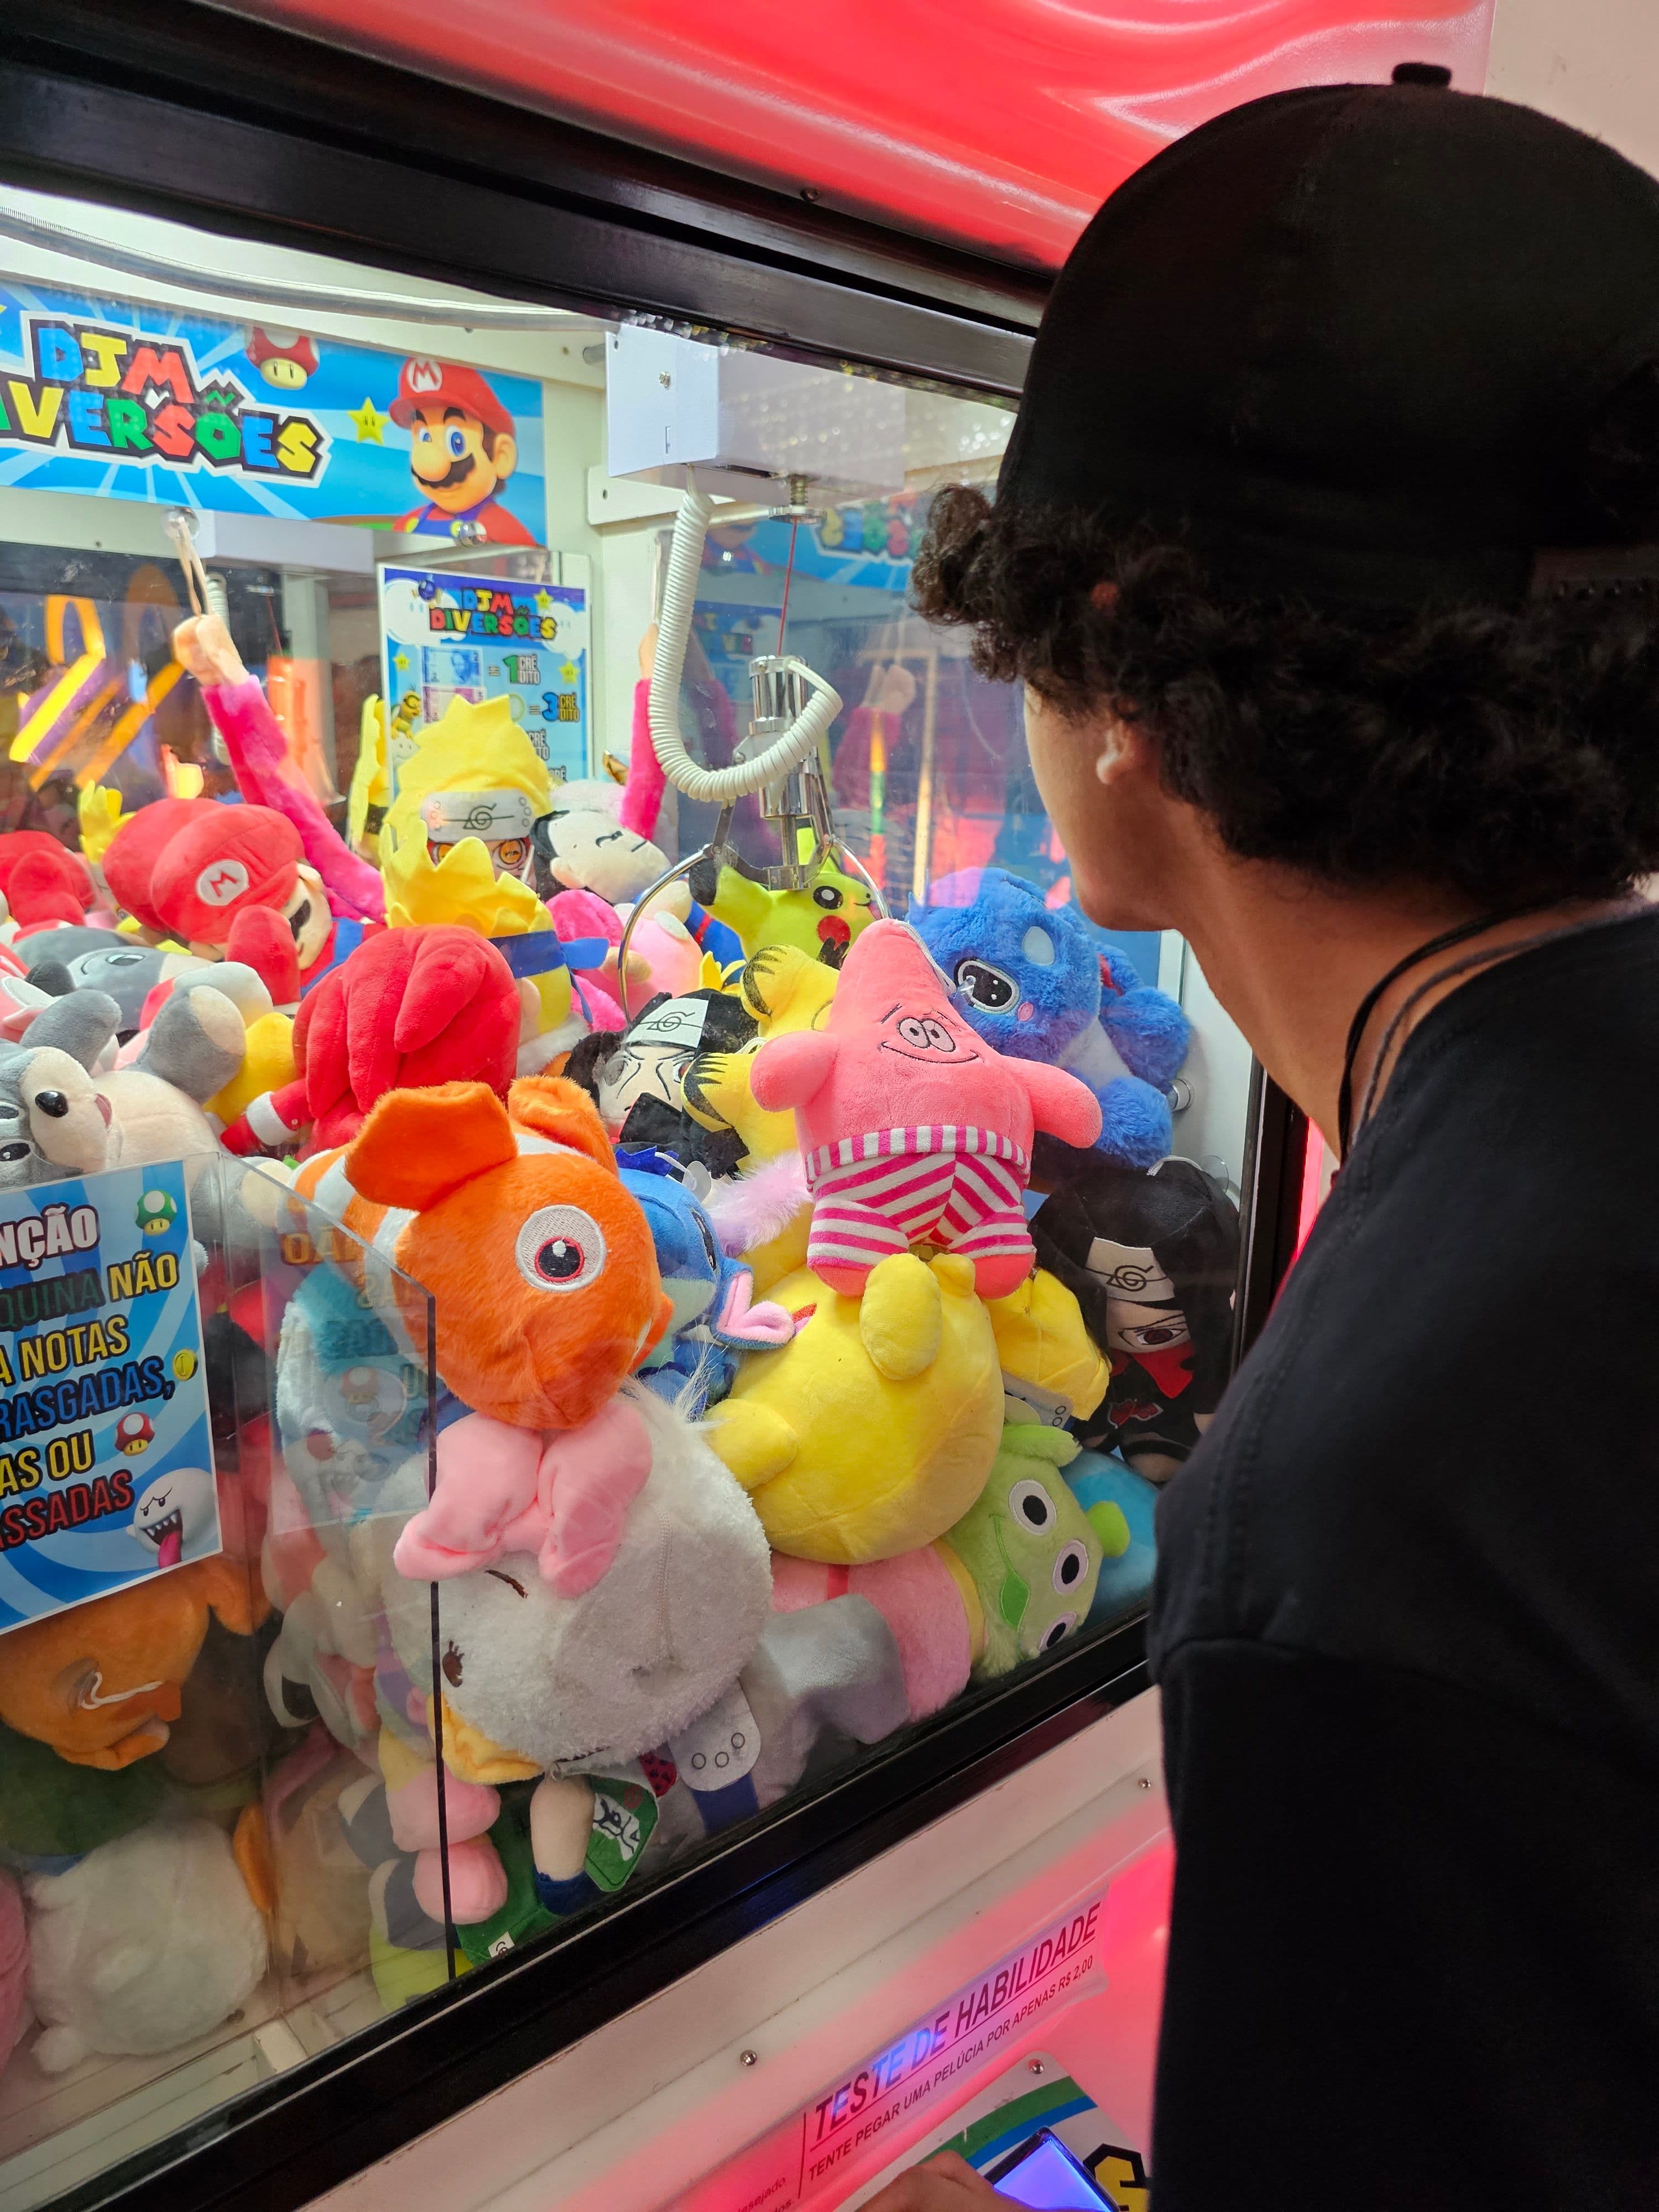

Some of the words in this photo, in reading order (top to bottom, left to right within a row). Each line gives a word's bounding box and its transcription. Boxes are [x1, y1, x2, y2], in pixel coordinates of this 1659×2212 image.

[37, 327, 195, 404] DJM
[430, 605, 556, 639] DIVERSÕES
[462, 588, 514, 615] DJM
[503, 655, 518, 682] 1
[542, 692, 559, 721] 3
[109, 1251, 178, 1301] NÃO
[21, 1317, 128, 1379] NOTAS
[49, 1433, 92, 1478] OU
[0, 1472, 132, 1548] SSADAS
[816, 2042, 906, 2142] TESTE
[911, 2011, 950, 2070] DE
[954, 1901, 1101, 2038] HABILIDADE
[809, 2136, 852, 2180] TENTE
[855, 2101, 900, 2147] PEGAR
[904, 2080, 931, 2110] UMA
[933, 2038, 984, 2088] PELÚCIA
[987, 2018, 1010, 2047] POR
[1011, 1984, 1056, 2028] APENAS
[1058, 1970, 1071, 1992] R$
[1072, 1955, 1093, 1981] 2,00
